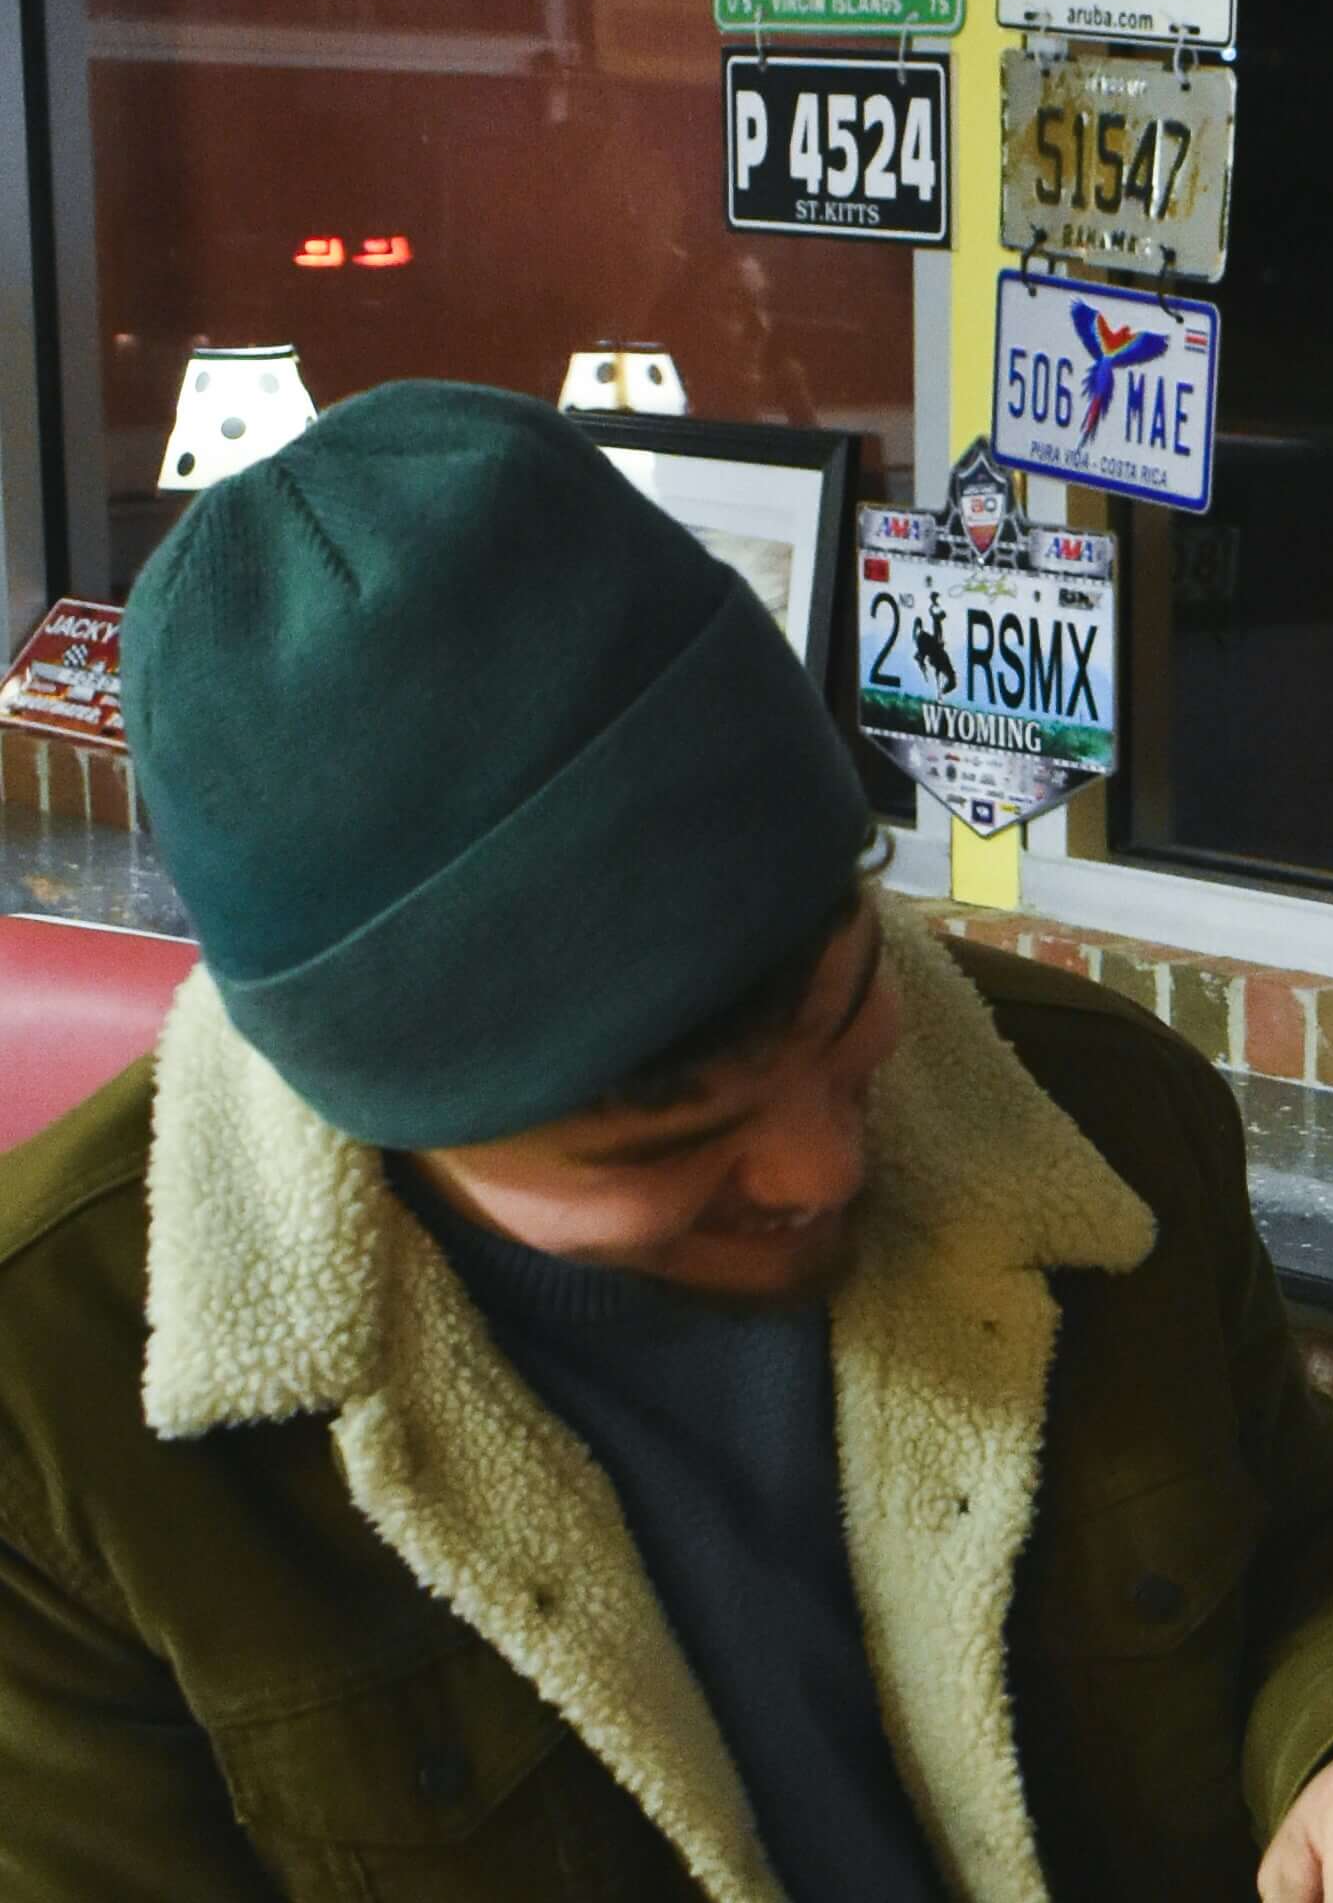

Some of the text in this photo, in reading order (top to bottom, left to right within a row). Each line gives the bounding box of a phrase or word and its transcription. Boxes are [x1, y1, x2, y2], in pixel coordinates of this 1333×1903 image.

[1066, 6, 1155, 31] aruba.com
[735, 90, 936, 201] P 4524
[1007, 347, 1195, 457] 506 MAE
[1030, 440, 1168, 487] PURA COSTA RICA
[966, 607, 1099, 722] RSMX
[921, 702, 1043, 754] WYOMING
